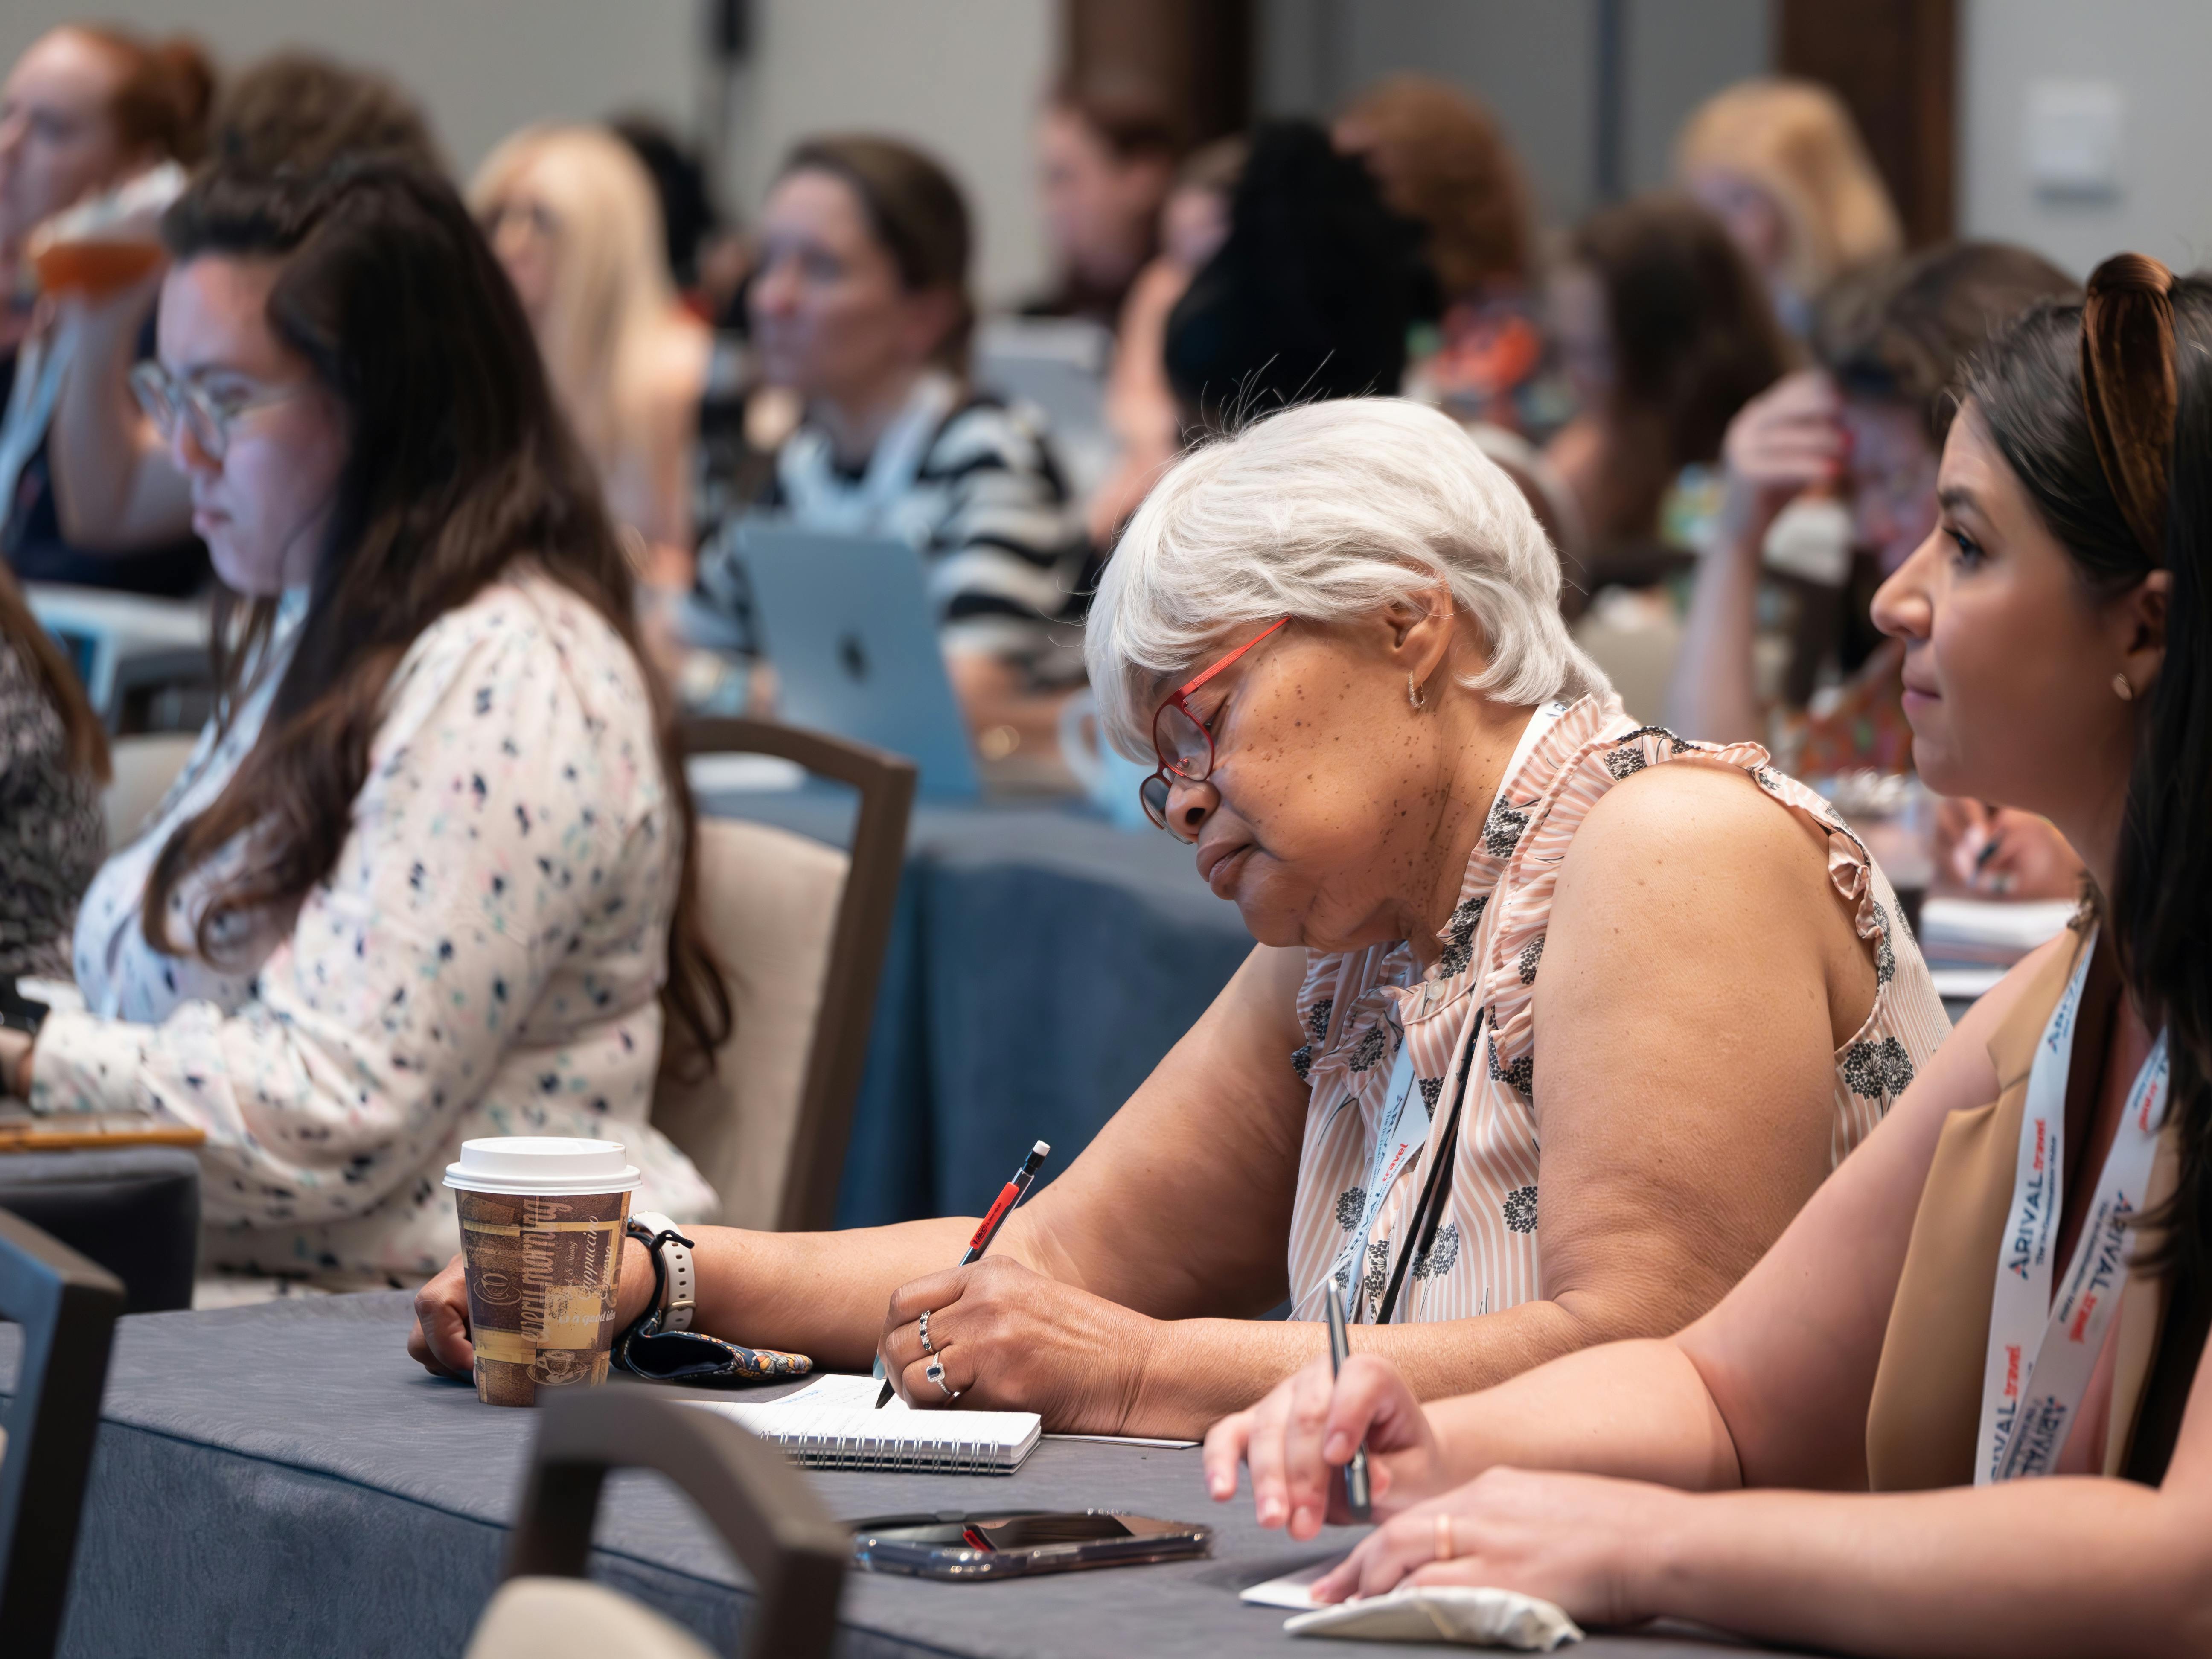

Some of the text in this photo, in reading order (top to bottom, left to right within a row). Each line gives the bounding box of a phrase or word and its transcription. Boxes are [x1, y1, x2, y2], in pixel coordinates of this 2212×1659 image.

[1382, 1142, 1409, 1182] travel
[522, 1197, 573, 1285] morning
[579, 1215, 599, 1300] Cappuccino
[976, 1225, 986, 1240] BIC
[2008, 1173, 2043, 1280] ARIVAL
